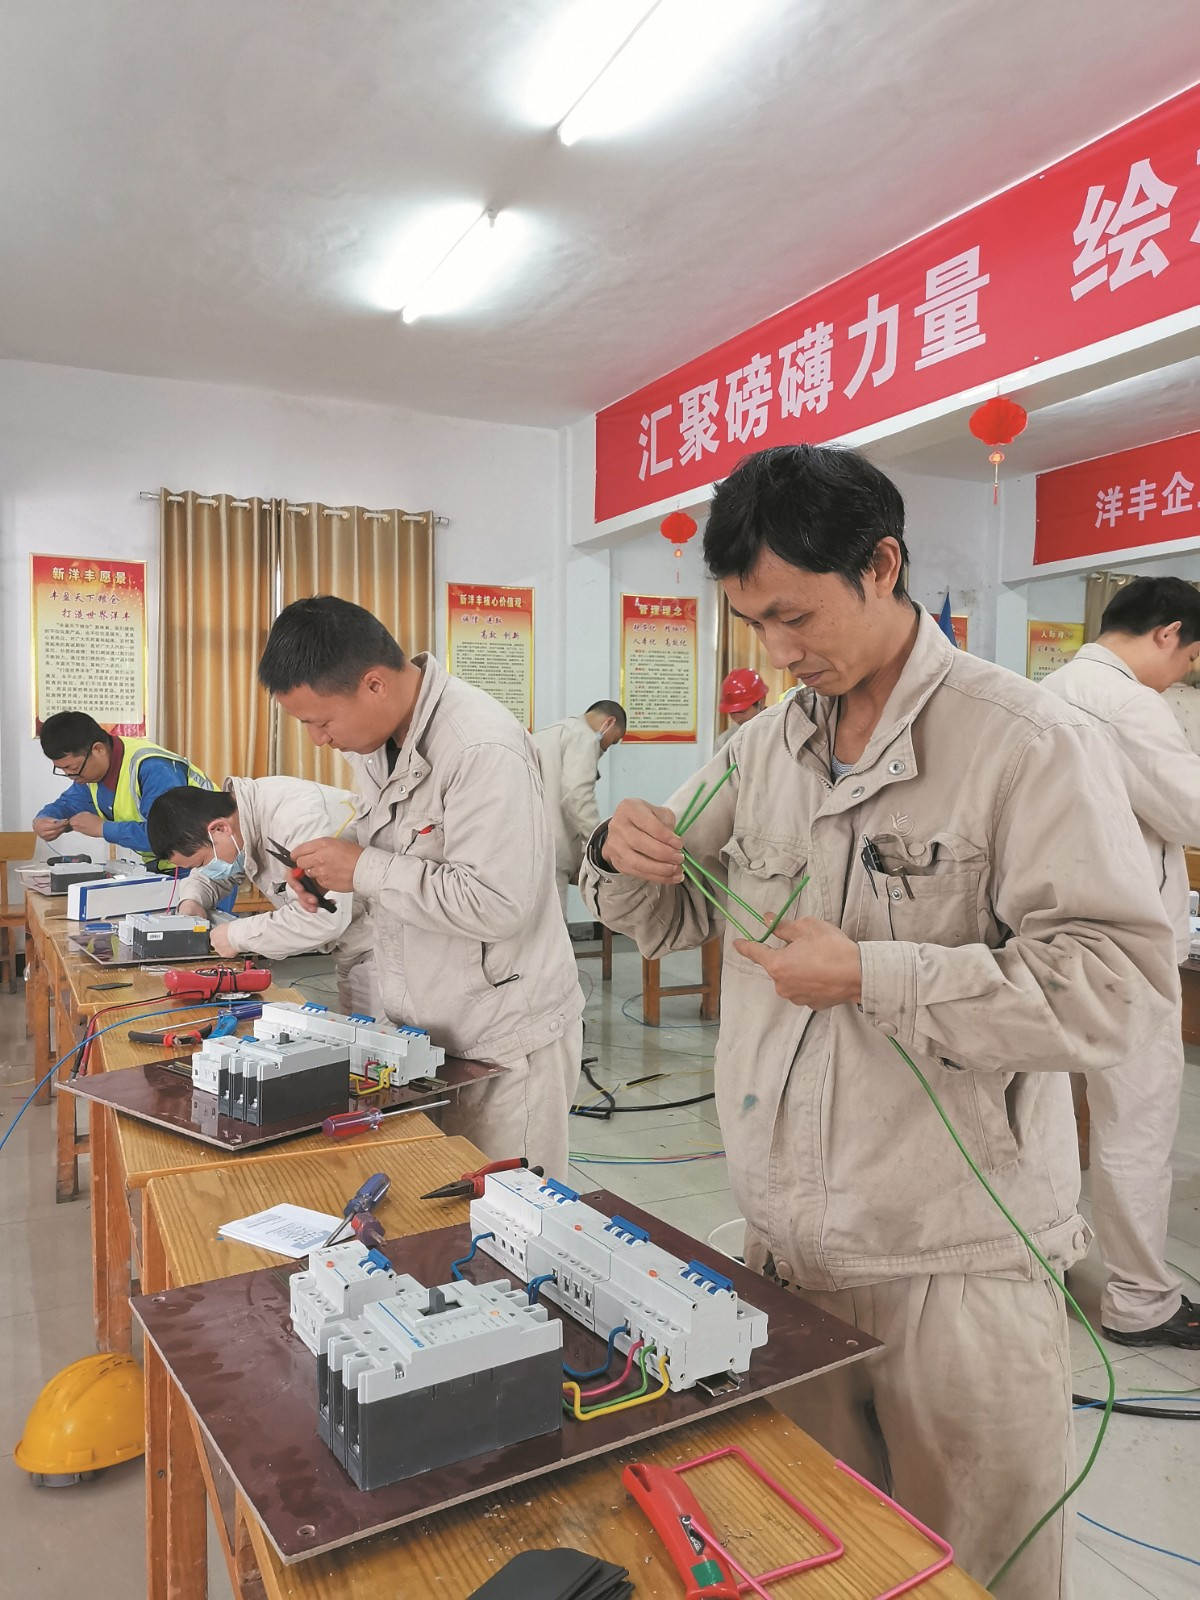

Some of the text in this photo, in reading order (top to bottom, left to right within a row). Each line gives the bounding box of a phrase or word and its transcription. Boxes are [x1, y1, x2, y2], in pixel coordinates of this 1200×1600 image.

[637, 148, 1200, 481] 汇聚磅礴力量 绘
[1094, 471, 1200, 529] 洋丰企
[51, 566, 128, 585] 新洋丰愿景
[459, 593, 523, 609] 新洋丰核心价值观
[61, 607, 131, 623] 打造世界洋丰
